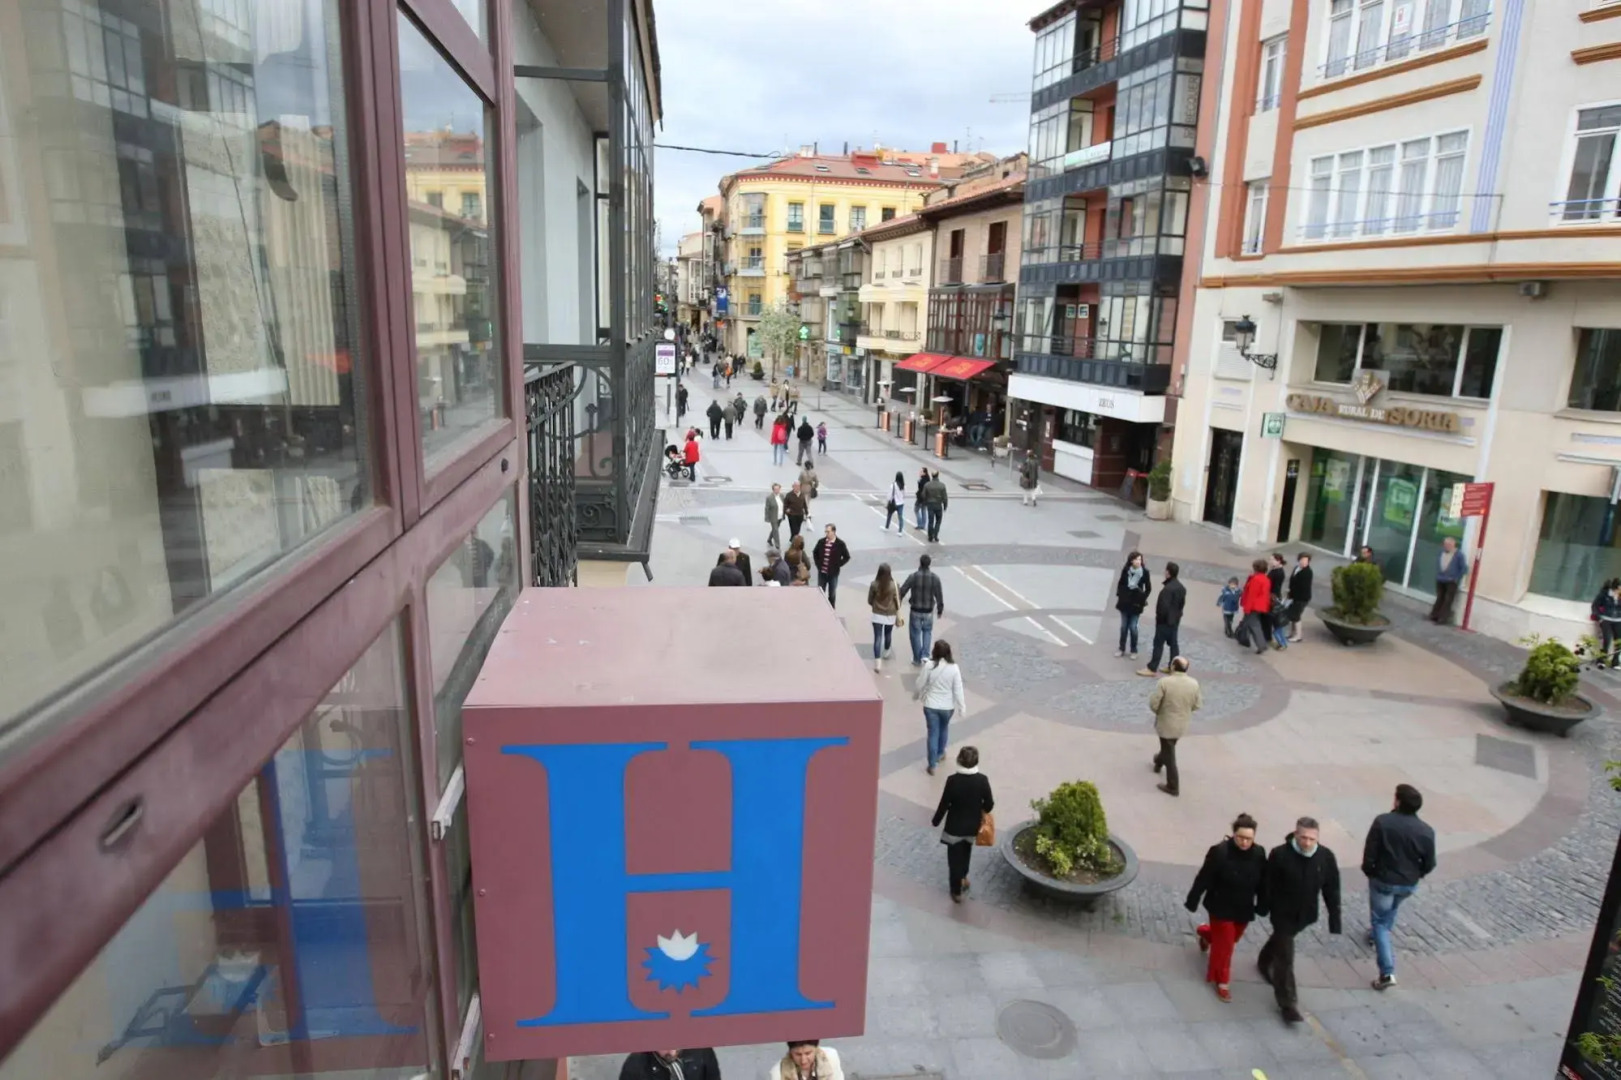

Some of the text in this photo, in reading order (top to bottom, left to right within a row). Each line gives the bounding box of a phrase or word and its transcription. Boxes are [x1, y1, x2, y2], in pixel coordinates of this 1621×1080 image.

[1338, 404, 1368, 418] RURAL
[1370, 408, 1385, 421] DE
[1387, 407, 1458, 432] SORIA
[501, 736, 850, 1027] H
